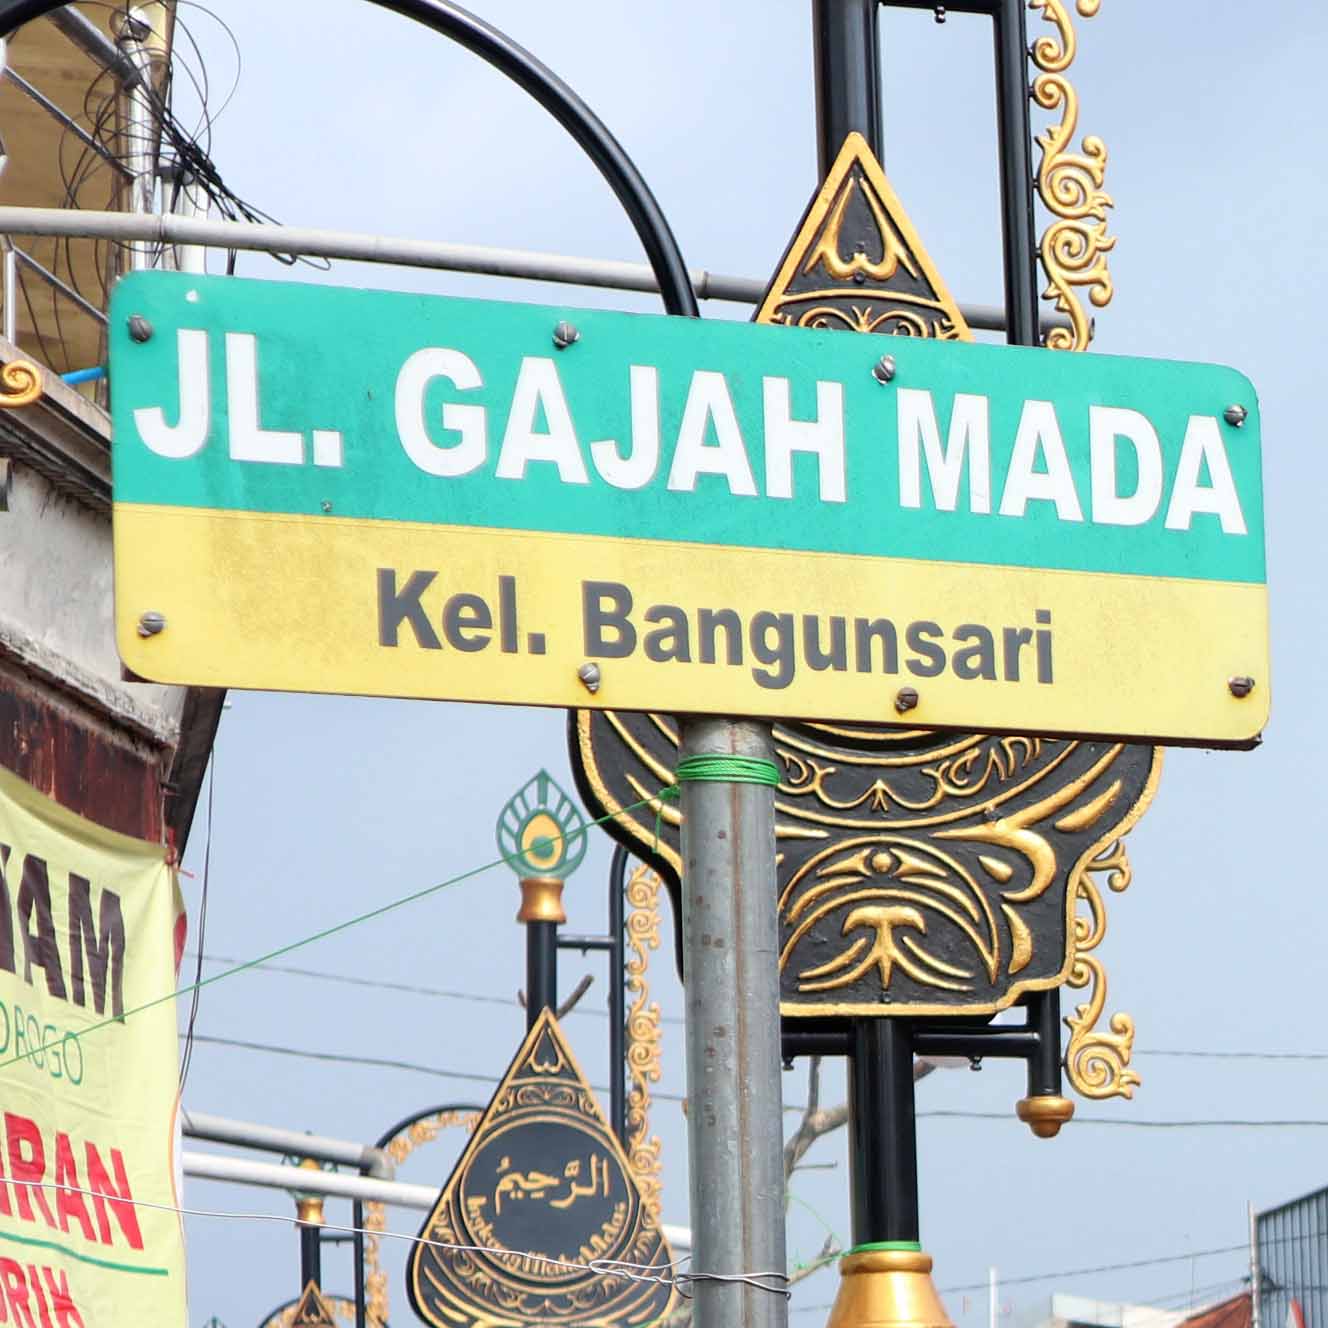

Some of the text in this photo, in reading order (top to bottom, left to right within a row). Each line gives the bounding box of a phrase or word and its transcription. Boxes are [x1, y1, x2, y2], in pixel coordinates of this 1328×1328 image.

[133, 328, 1248, 535] JL. GAJAH MADA
[376, 568, 1055, 690] Kel. Bangunsari
